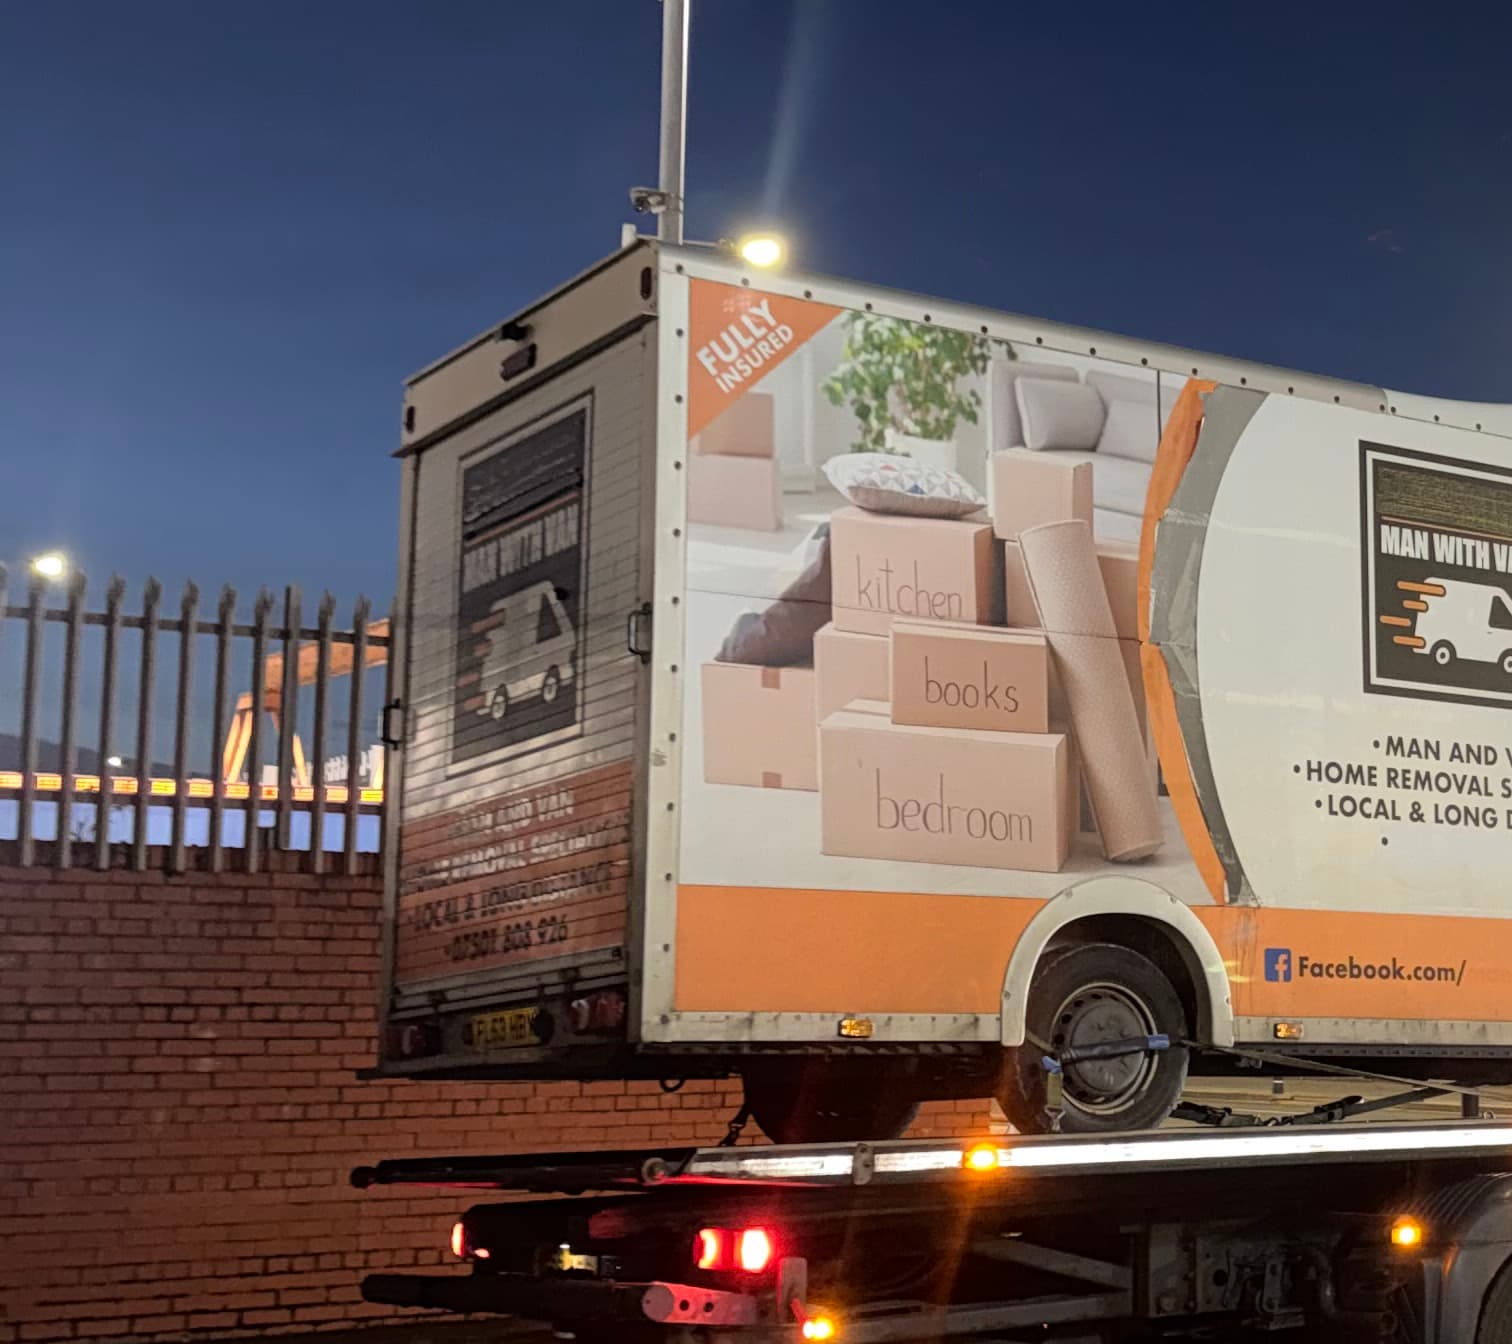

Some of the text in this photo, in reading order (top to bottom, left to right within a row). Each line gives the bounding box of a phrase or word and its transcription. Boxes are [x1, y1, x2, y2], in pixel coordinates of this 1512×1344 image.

[696, 298, 777, 377] FULLY
[715, 324, 794, 393] INSURED
[1380, 524, 1429, 561] MAN
[1432, 532, 1490, 570] WITH
[856, 554, 962, 620] kitchen
[925, 656, 1018, 713] books
[1385, 736, 1440, 761] MAN
[1449, 743, 1498, 766] AND
[1306, 760, 1378, 787] HOME
[1386, 767, 1493, 797] REMOVAL
[876, 768, 1032, 843] bedroom
[1328, 794, 1401, 821] LOCAL
[1409, 801, 1426, 823] &
[1434, 804, 1498, 828] LONG
[1298, 955, 1467, 987] Facebook.com/
